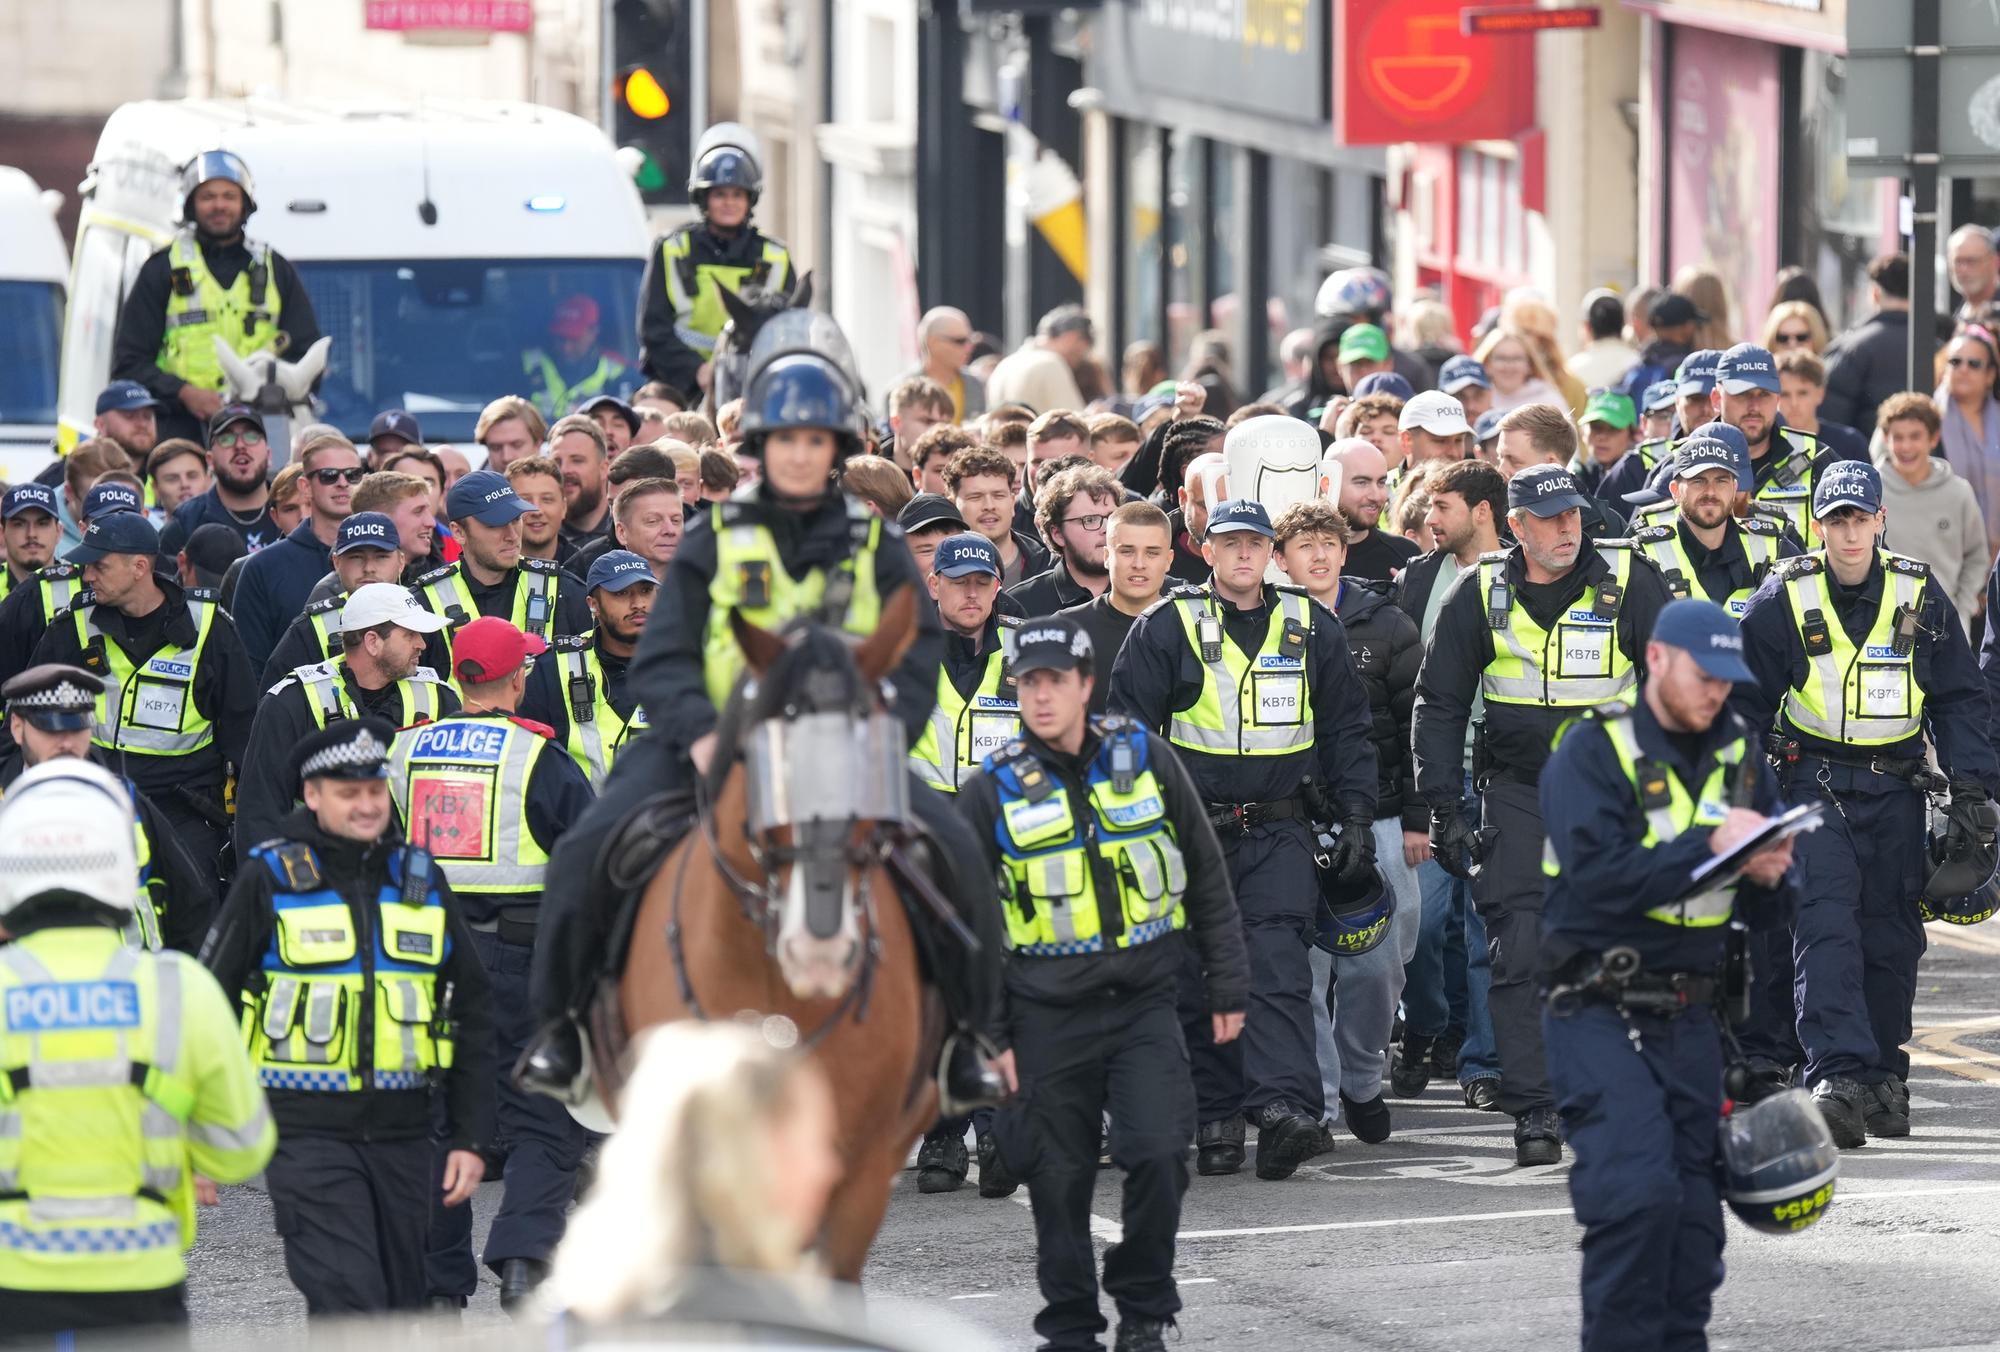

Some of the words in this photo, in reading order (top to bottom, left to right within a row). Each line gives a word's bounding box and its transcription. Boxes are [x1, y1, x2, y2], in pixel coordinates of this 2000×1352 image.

[1690, 367, 1717, 377] POLIC
[1736, 363, 1769, 371] POLICE
[1437, 407, 1462, 417] POLIC
[1691, 446, 1728, 460] POLICE
[1537, 476, 1573, 495] POLICE
[1823, 483, 1865, 499] POLICE
[14, 489, 49, 503] POLICE
[100, 490, 135, 506] POLICE
[484, 487, 514, 503] POLICE
[1230, 505, 1257, 515] POLICE
[347, 524, 385, 539] POLICE
[954, 547, 991, 562] POLICE
[614, 561, 647, 573] POLICE
[1571, 612, 1610, 622] POLI
[1020, 629, 1067, 647] POLICE
[1261, 657, 1300, 667] POLICE
[1565, 649, 1601, 661] KB7B
[151, 660, 191, 676] POLICE
[1867, 688, 1901, 699] KB7B
[145, 700, 178, 714] KB7A
[980, 698, 1017, 707] POLICE
[1262, 696, 1296, 708] KB7B
[416, 729, 502, 754] POLICE
[425, 794, 470, 815] KB7
[1943, 909, 1993, 925] EB421
[9, 986, 136, 1025] POLICE
